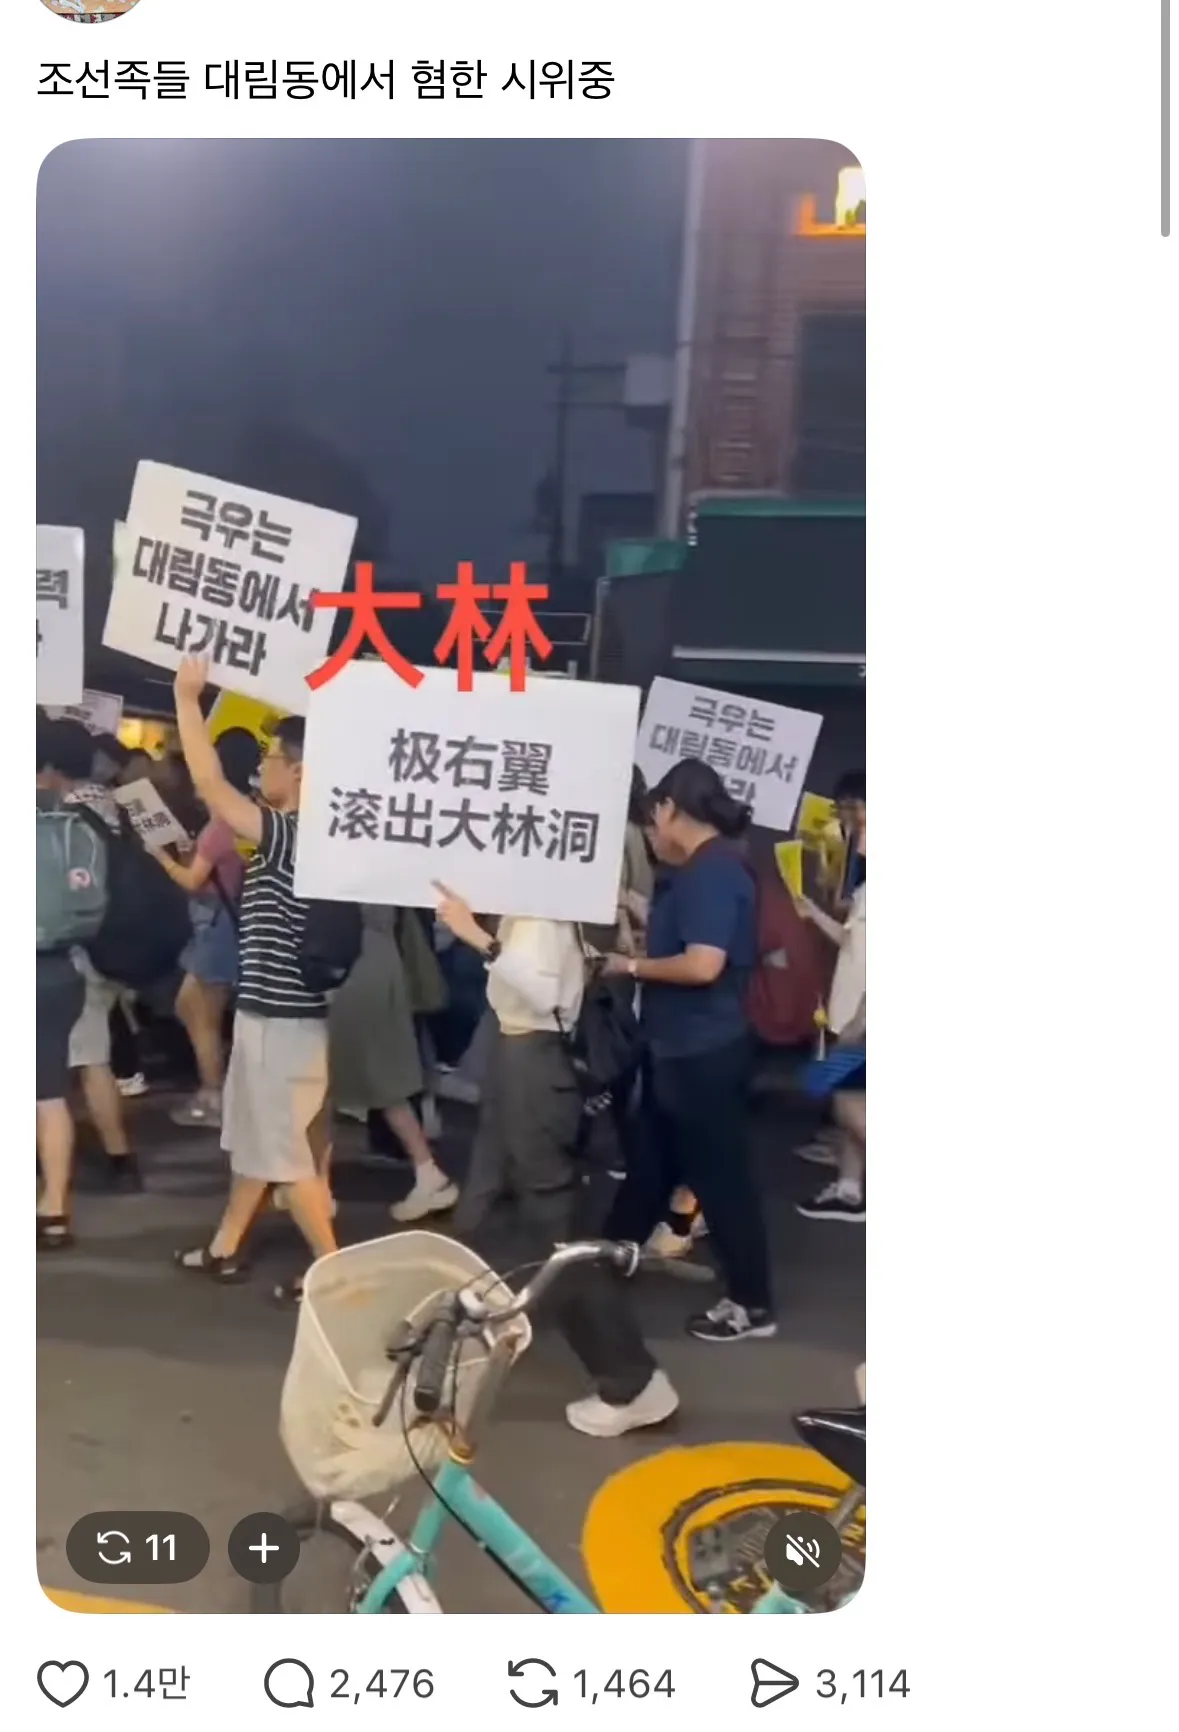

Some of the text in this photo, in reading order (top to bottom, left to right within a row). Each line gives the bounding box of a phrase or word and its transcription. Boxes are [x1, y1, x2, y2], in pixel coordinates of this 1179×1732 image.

[181, 489, 292, 563] 극우는
[132, 536, 320, 632] 대림동에서
[154, 602, 267, 676] 나가라
[648, 723, 798, 783] 대림동에서
[688, 695, 775, 742] 극우는
[388, 728, 553, 796] 极右翼
[328, 786, 600, 863] 滚出大林洞
